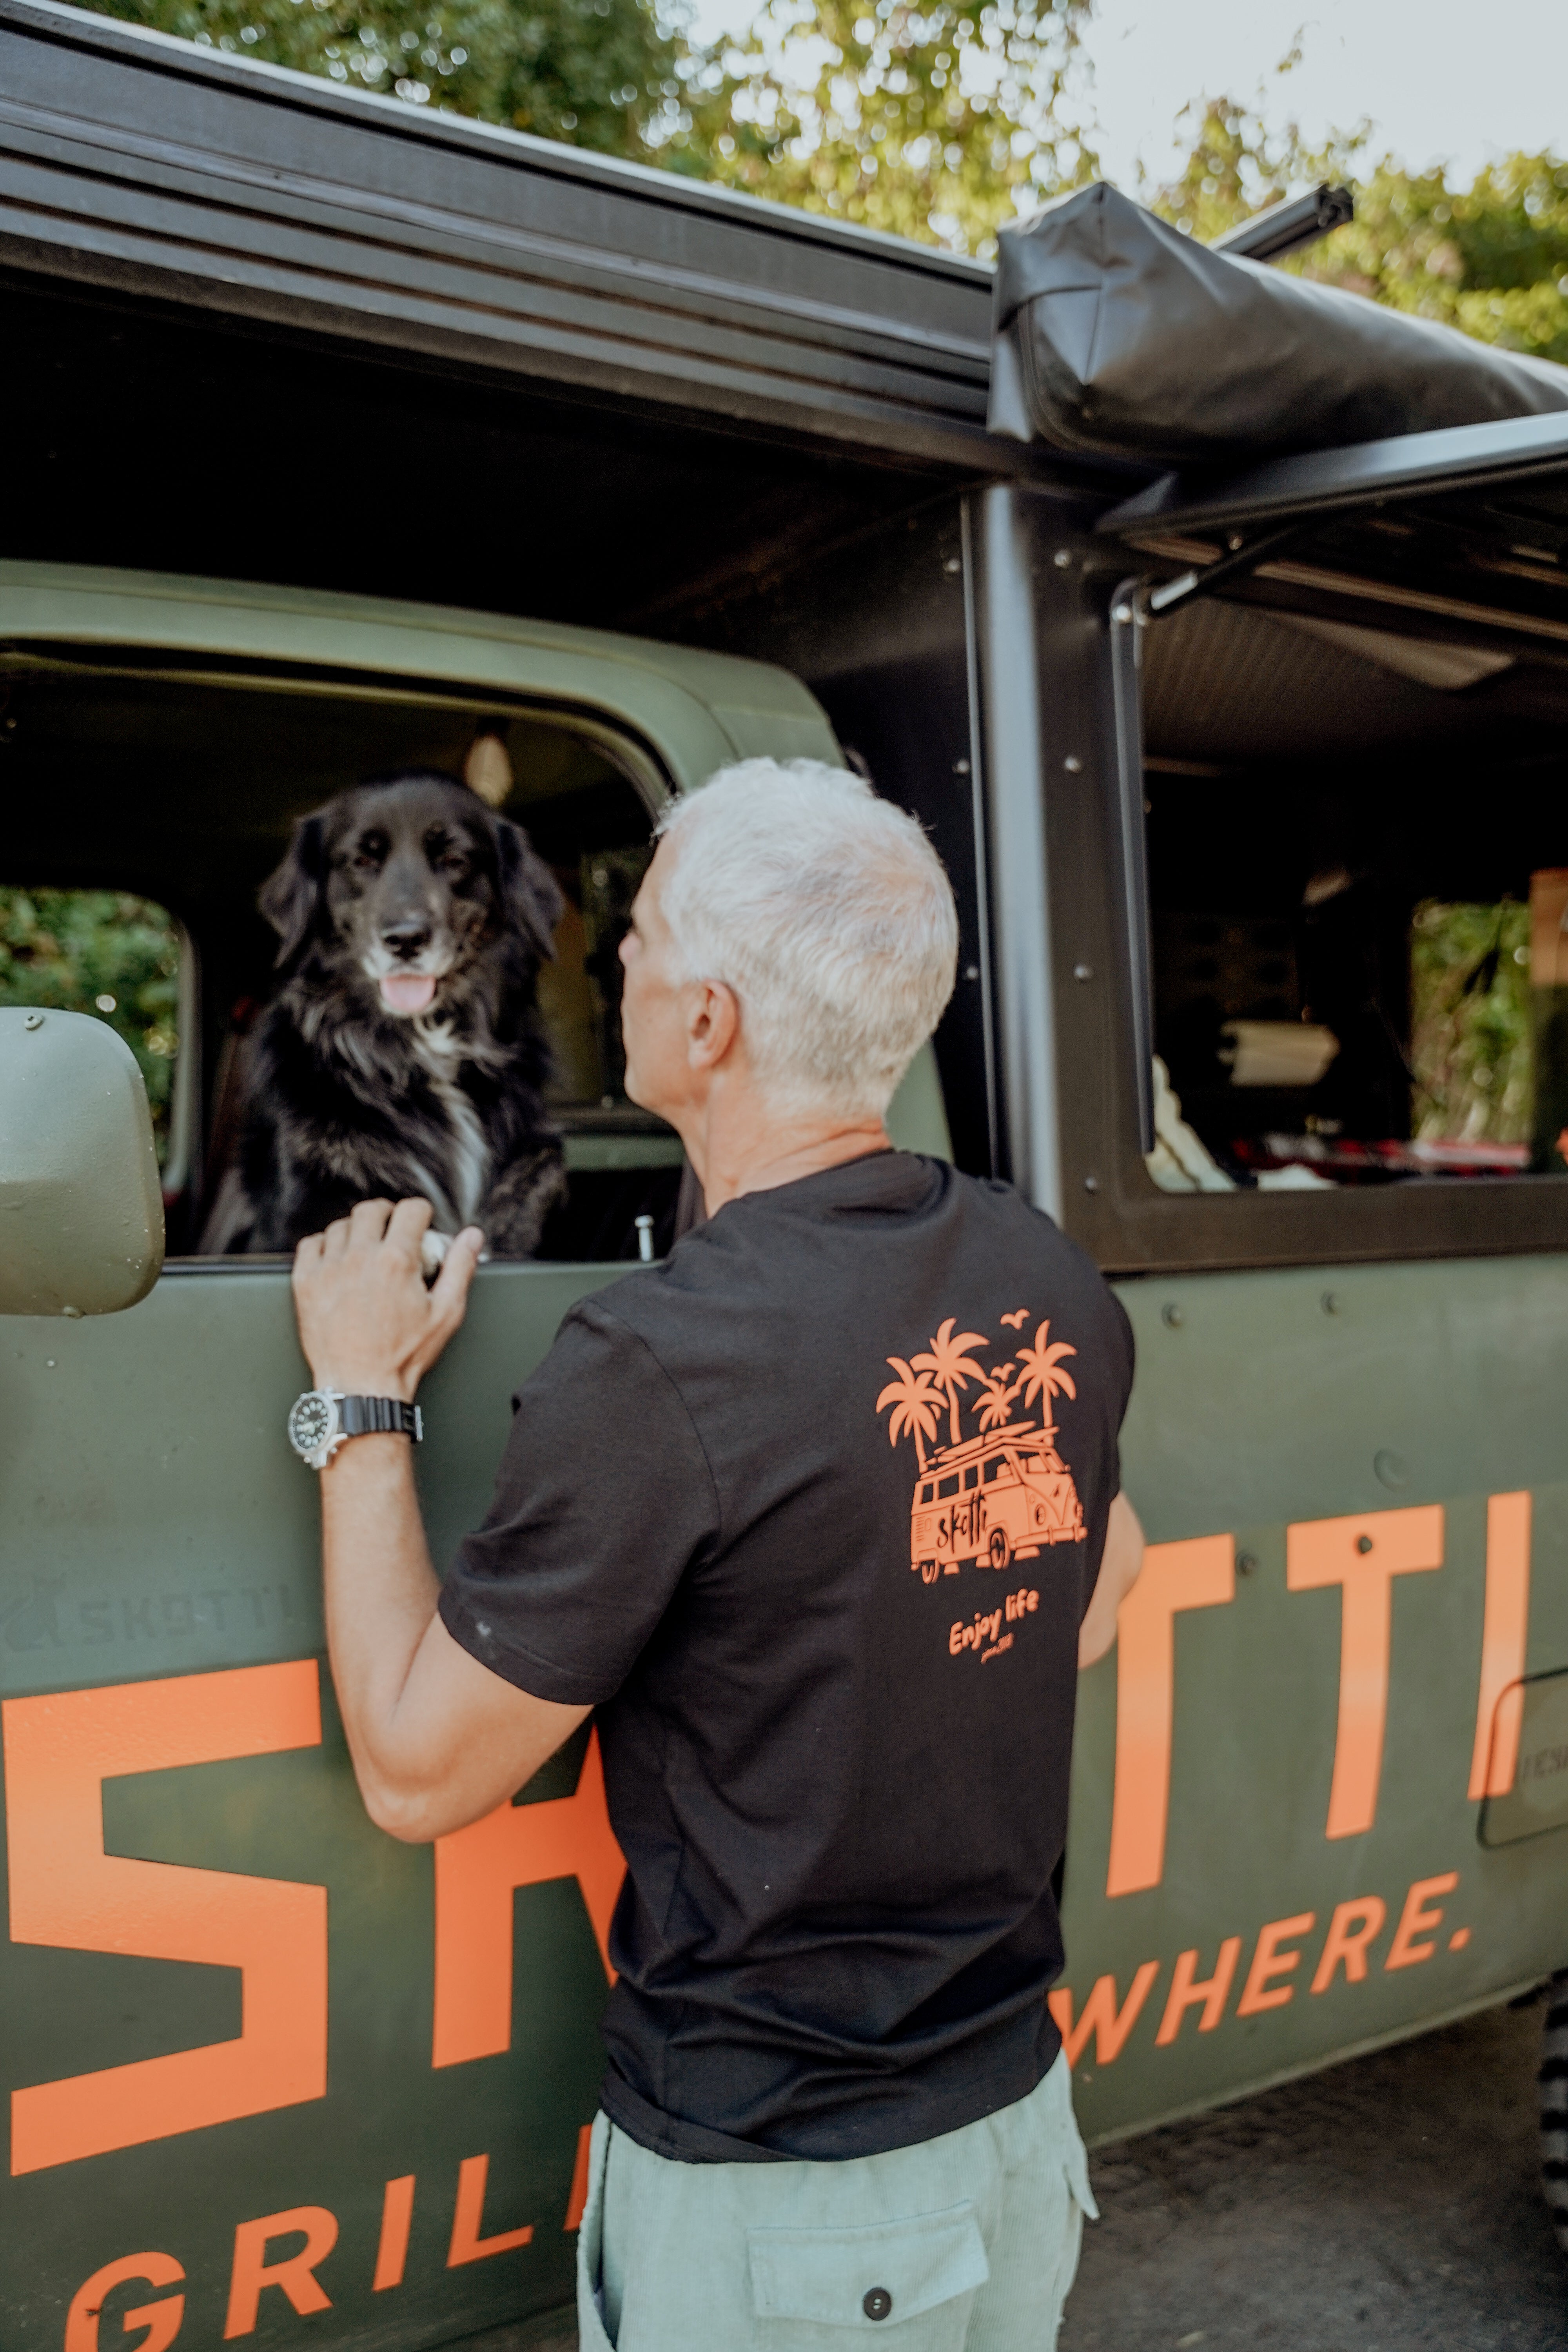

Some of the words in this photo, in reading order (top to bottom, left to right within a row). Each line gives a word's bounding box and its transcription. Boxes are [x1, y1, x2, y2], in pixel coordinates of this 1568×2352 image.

[949, 1608, 1002, 1655] Enjoy
[1005, 1588, 1040, 1622] life
[2, 1491, 1532, 2176] STTI
